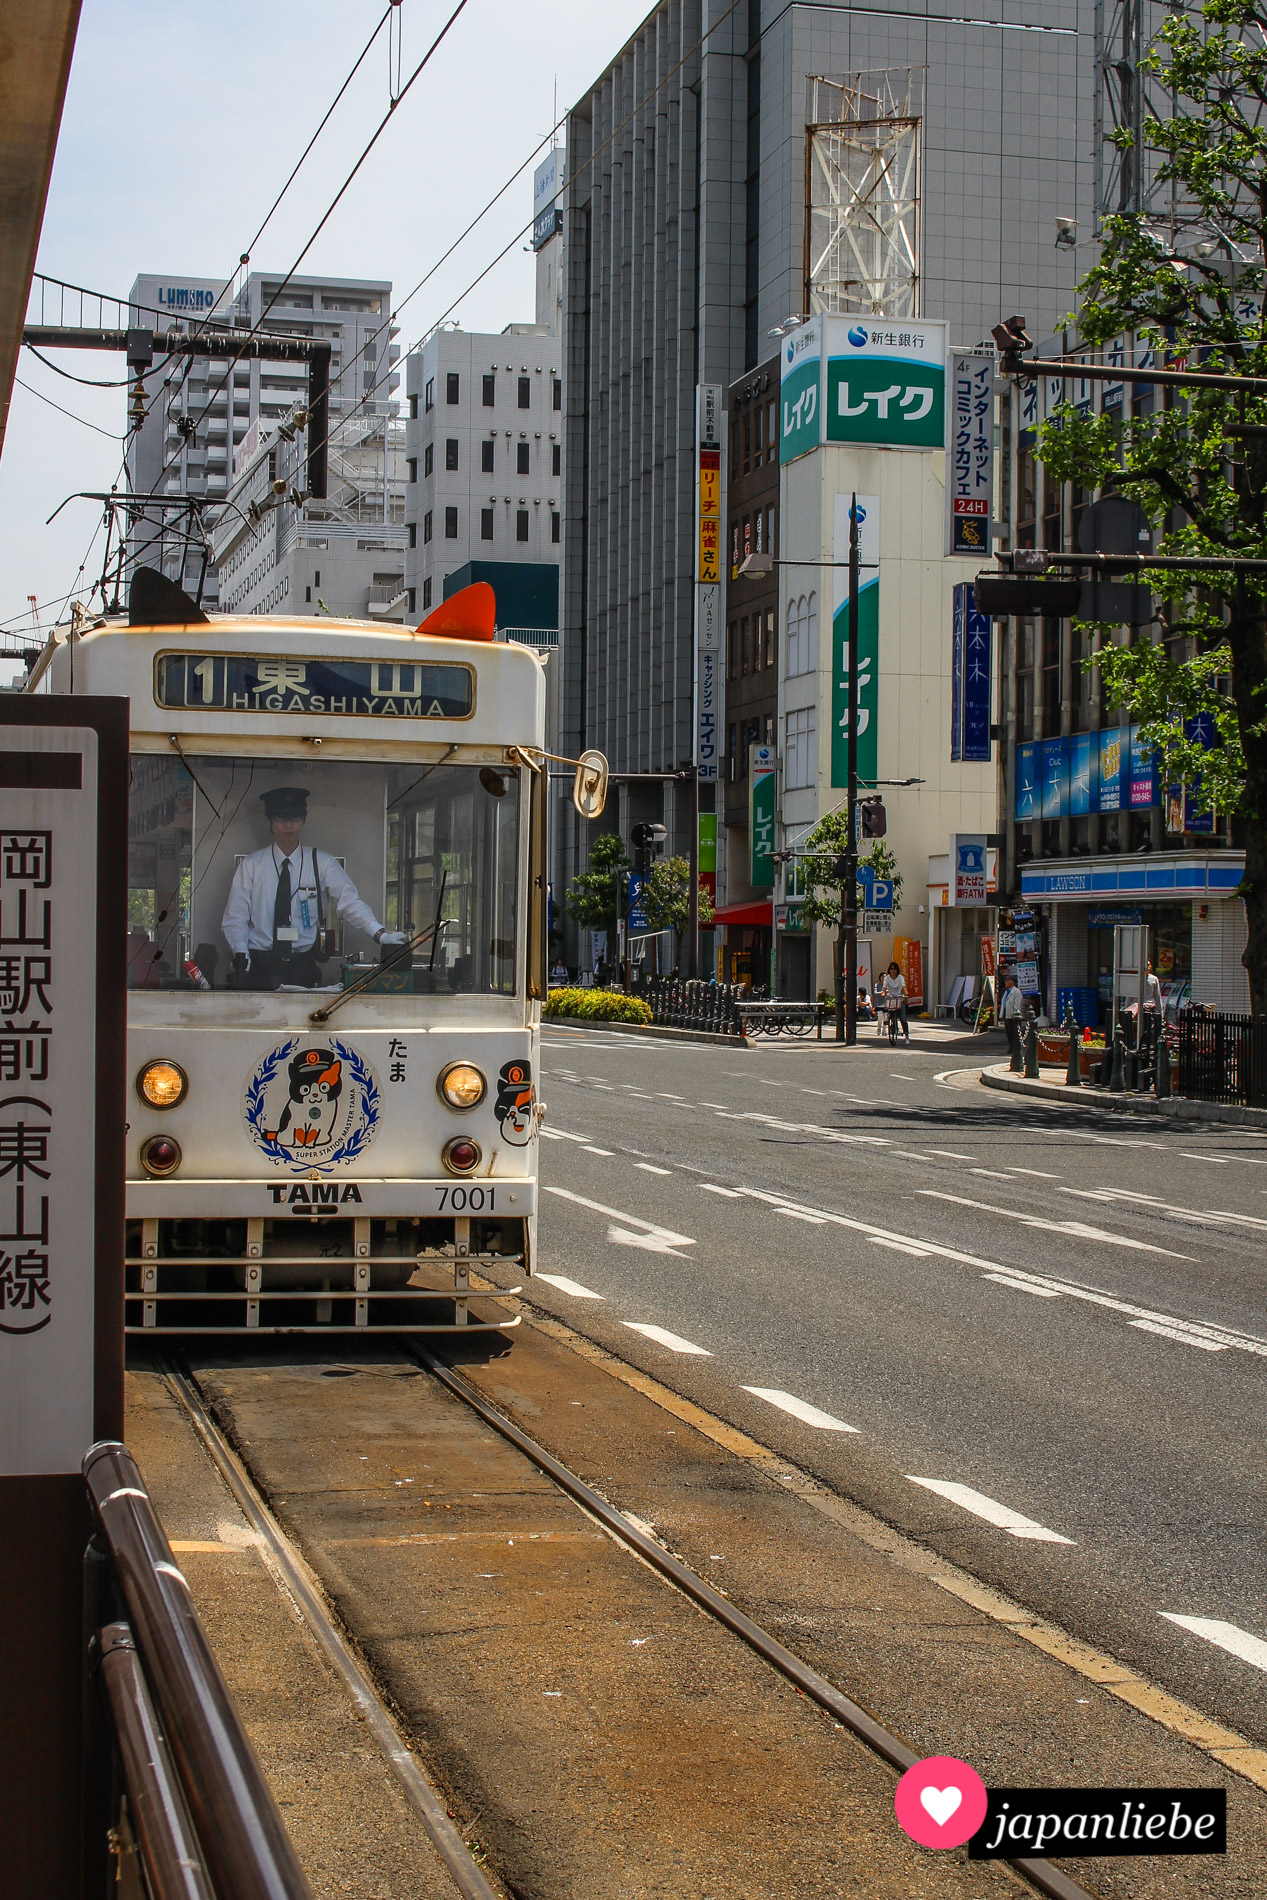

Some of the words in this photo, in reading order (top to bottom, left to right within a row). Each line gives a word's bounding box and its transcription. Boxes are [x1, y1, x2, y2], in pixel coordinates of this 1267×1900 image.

[795, 330, 815, 354] 新生銀行
[871, 331, 925, 349] 新生銀行
[957, 360, 970, 373] 4F
[783, 383, 817, 438] レイク
[838, 381, 934, 421] レイク
[955, 380, 972, 496] コミックカフェ
[973, 366, 990, 488] インターネット
[702, 472, 717, 513] リーチ
[957, 500, 984, 513] 24H
[702, 520, 717, 580] 麻雀さん
[194, 656, 214, 704] 1
[704, 655, 713, 709] キャッシング
[232, 691, 445, 717] HIGASHIYAMA
[700, 712, 715, 760] エイワ
[698, 764, 717, 777] 3F
[754, 806, 773, 858] レイク
[872, 882, 889, 906] P
[1050, 876, 1086, 890] LAWSON
[388, 1038, 408, 1083] たま
[319, 1136, 344, 1157] STATION
[341, 1110, 355, 1138] MASTER
[266, 1183, 363, 1203] TAMA
[434, 1187, 496, 1211] 7001
